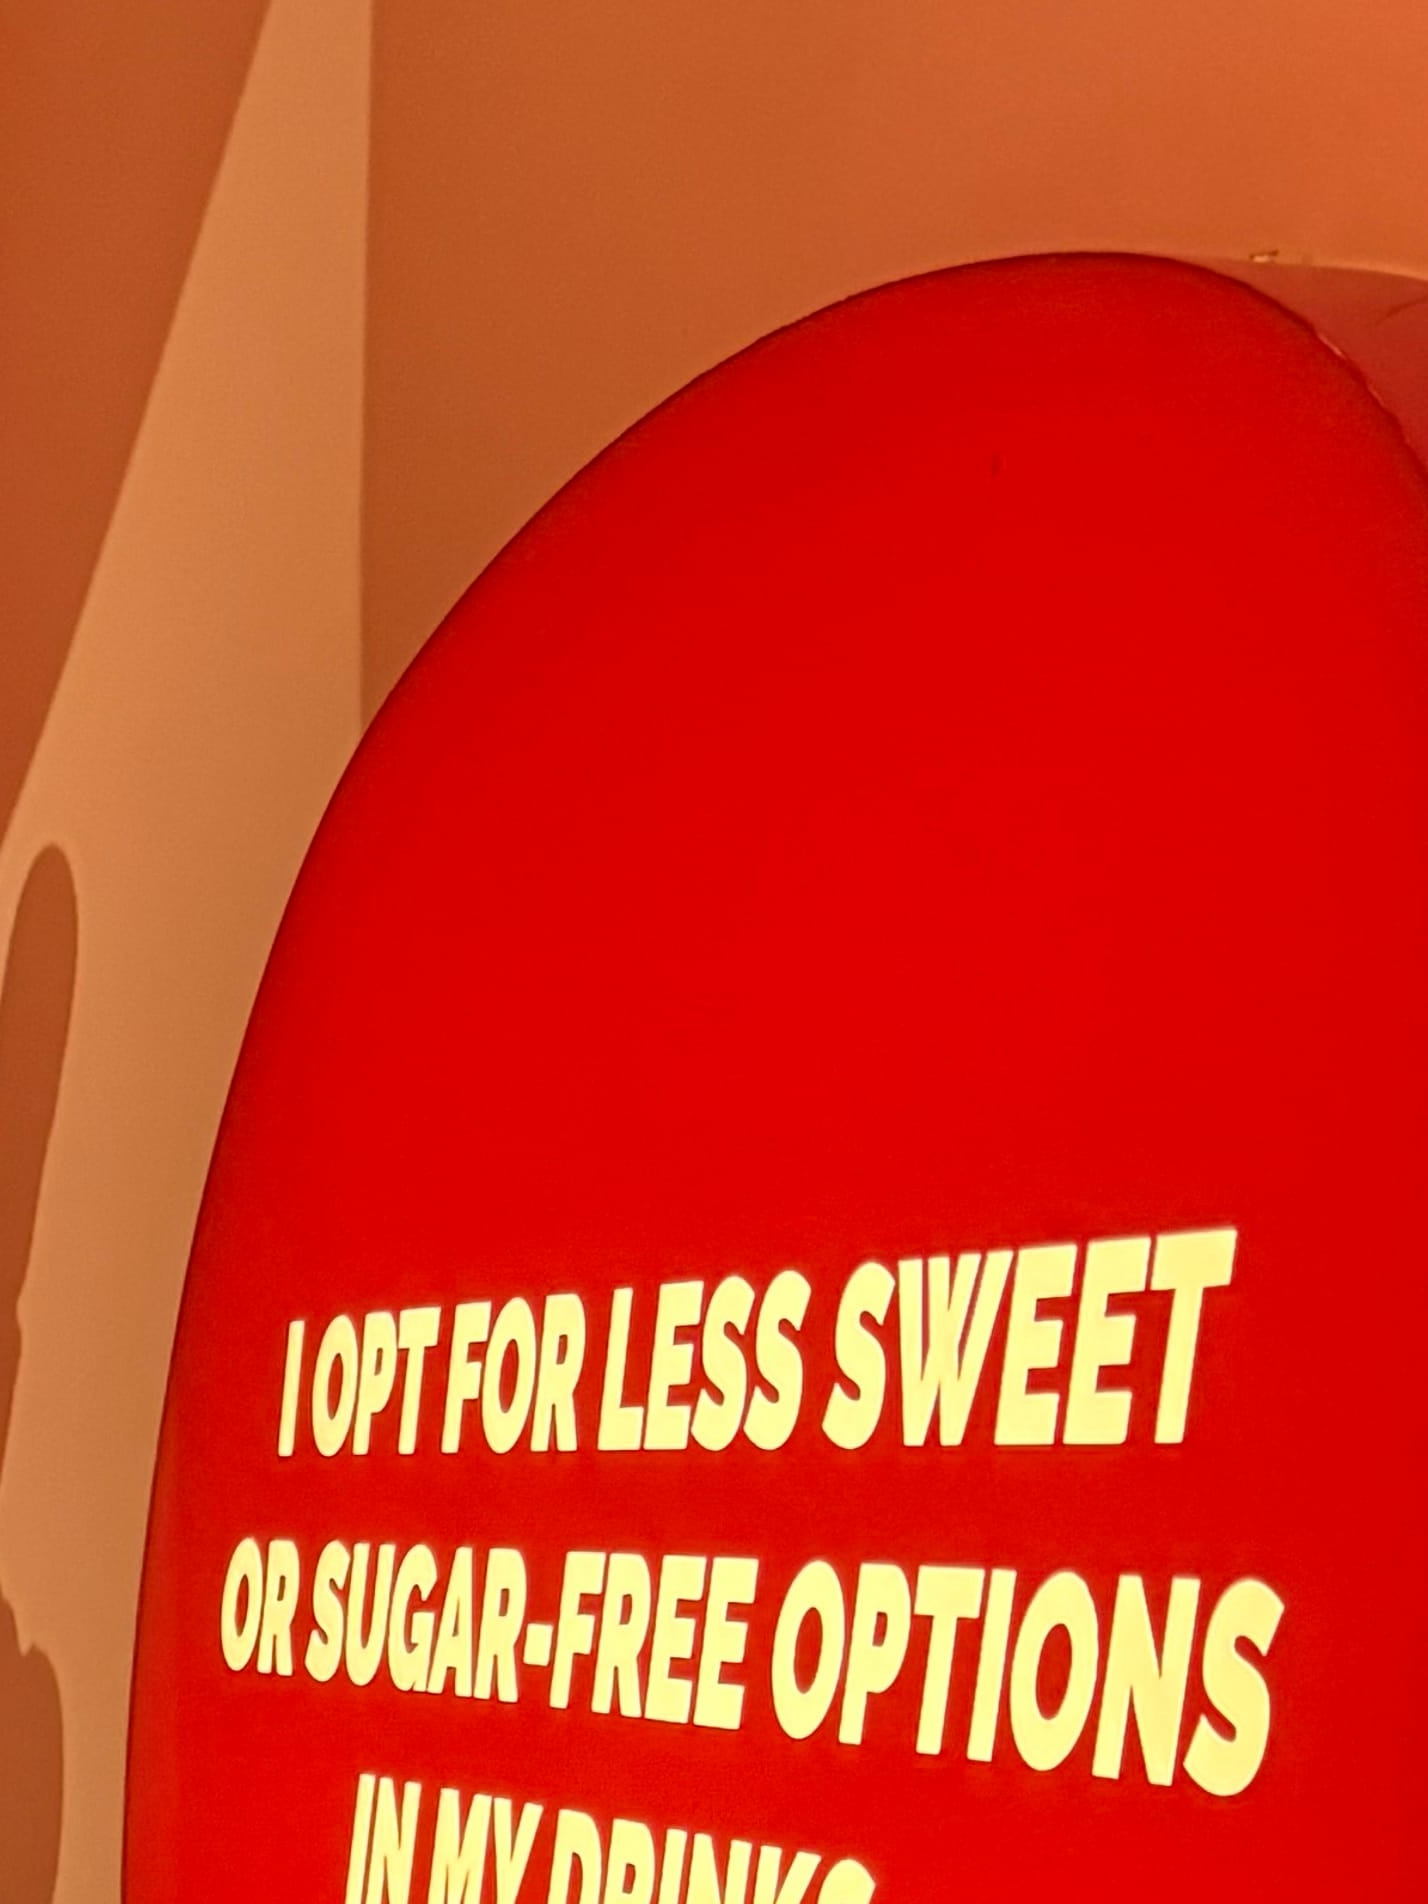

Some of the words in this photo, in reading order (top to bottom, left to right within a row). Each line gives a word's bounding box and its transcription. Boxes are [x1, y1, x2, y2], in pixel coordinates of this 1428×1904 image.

[278, 1319, 305, 1457] I
[312, 1306, 442, 1457] OPT
[441, 1292, 586, 1454] FOR
[597, 1269, 812, 1452] LESS
[821, 1227, 1238, 1450] SWEET
[220, 1537, 300, 1676] OR
[304, 1539, 760, 1730] SUGAR-FREE
[771, 1559, 1285, 1797] OPTIONS
